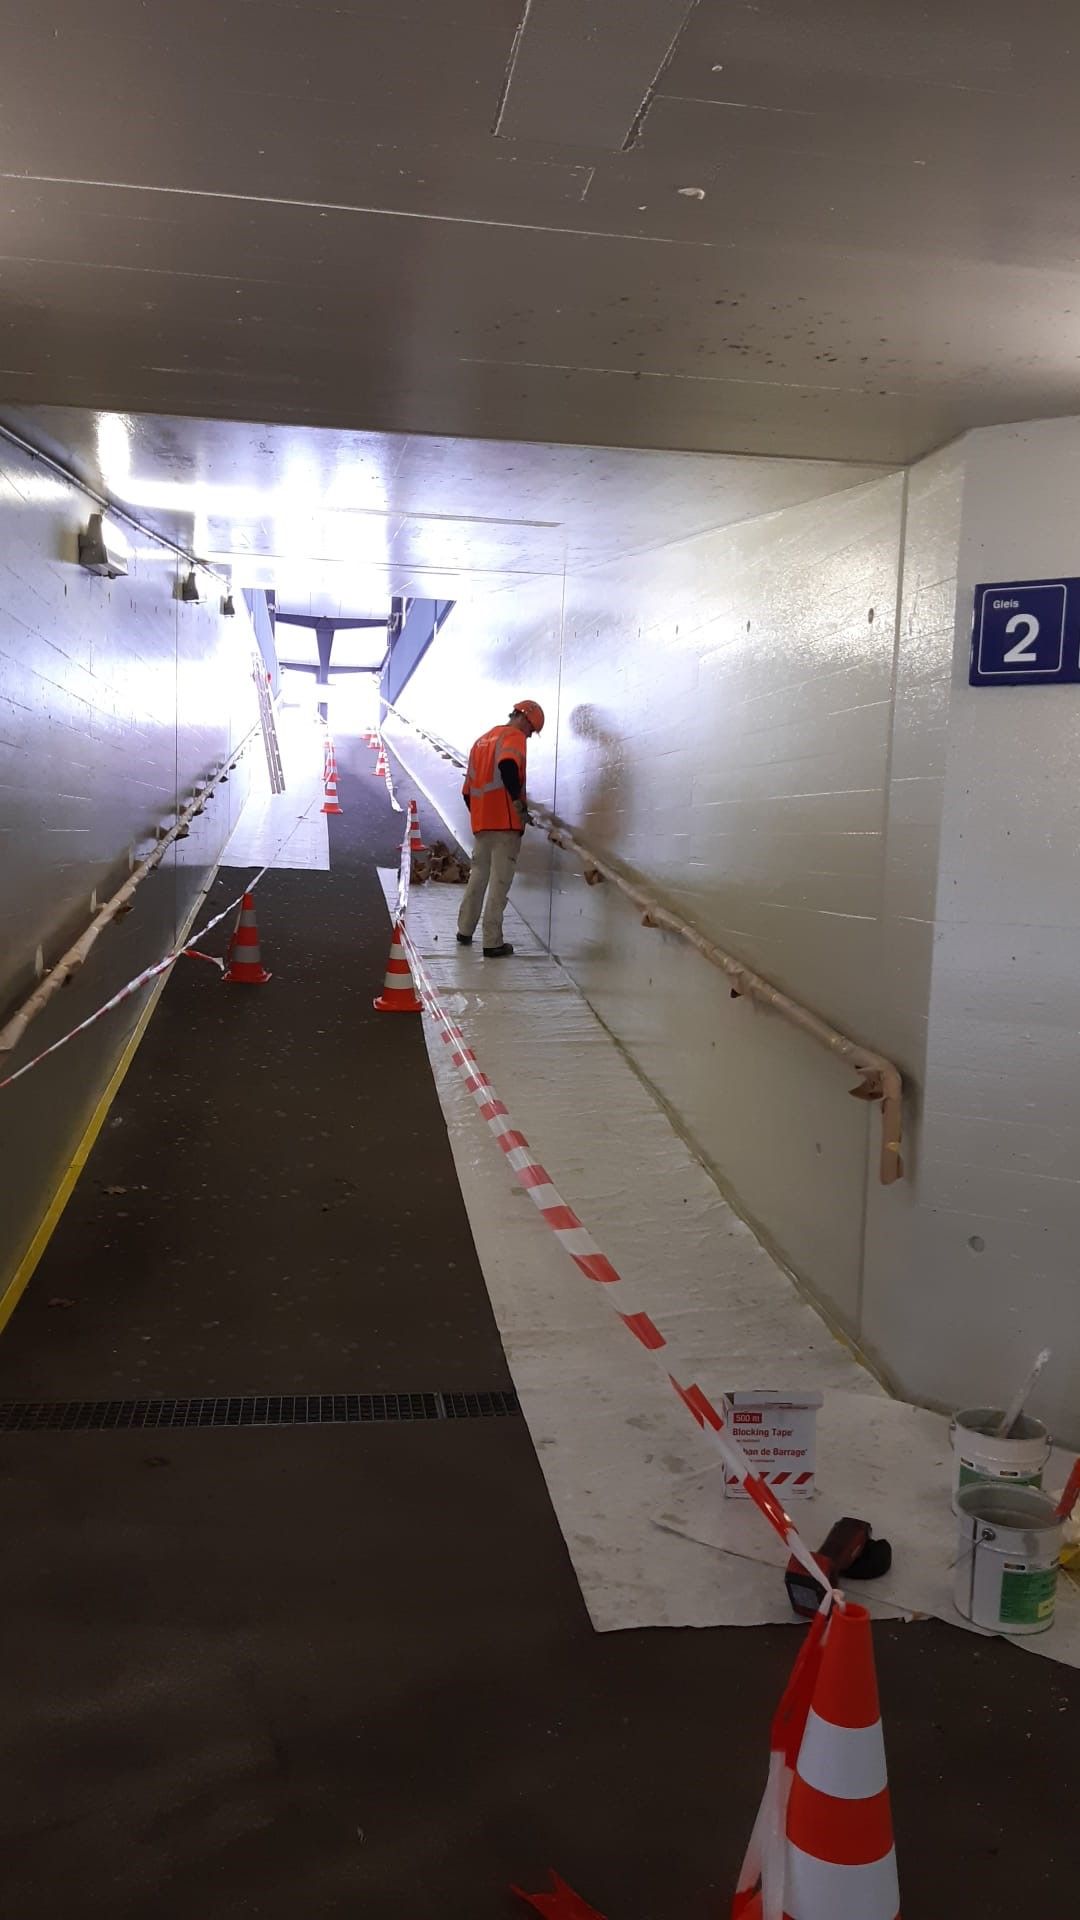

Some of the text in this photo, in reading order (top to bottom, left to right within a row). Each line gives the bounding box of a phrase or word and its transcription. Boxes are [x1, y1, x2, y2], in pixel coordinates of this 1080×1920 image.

[993, 599, 1019, 609] Gleis
[1003, 613, 1040, 663] 2
[735, 1414, 750, 1423] 500
[732, 1428, 769, 1437] Blocking
[760, 1448, 771, 1456] de
